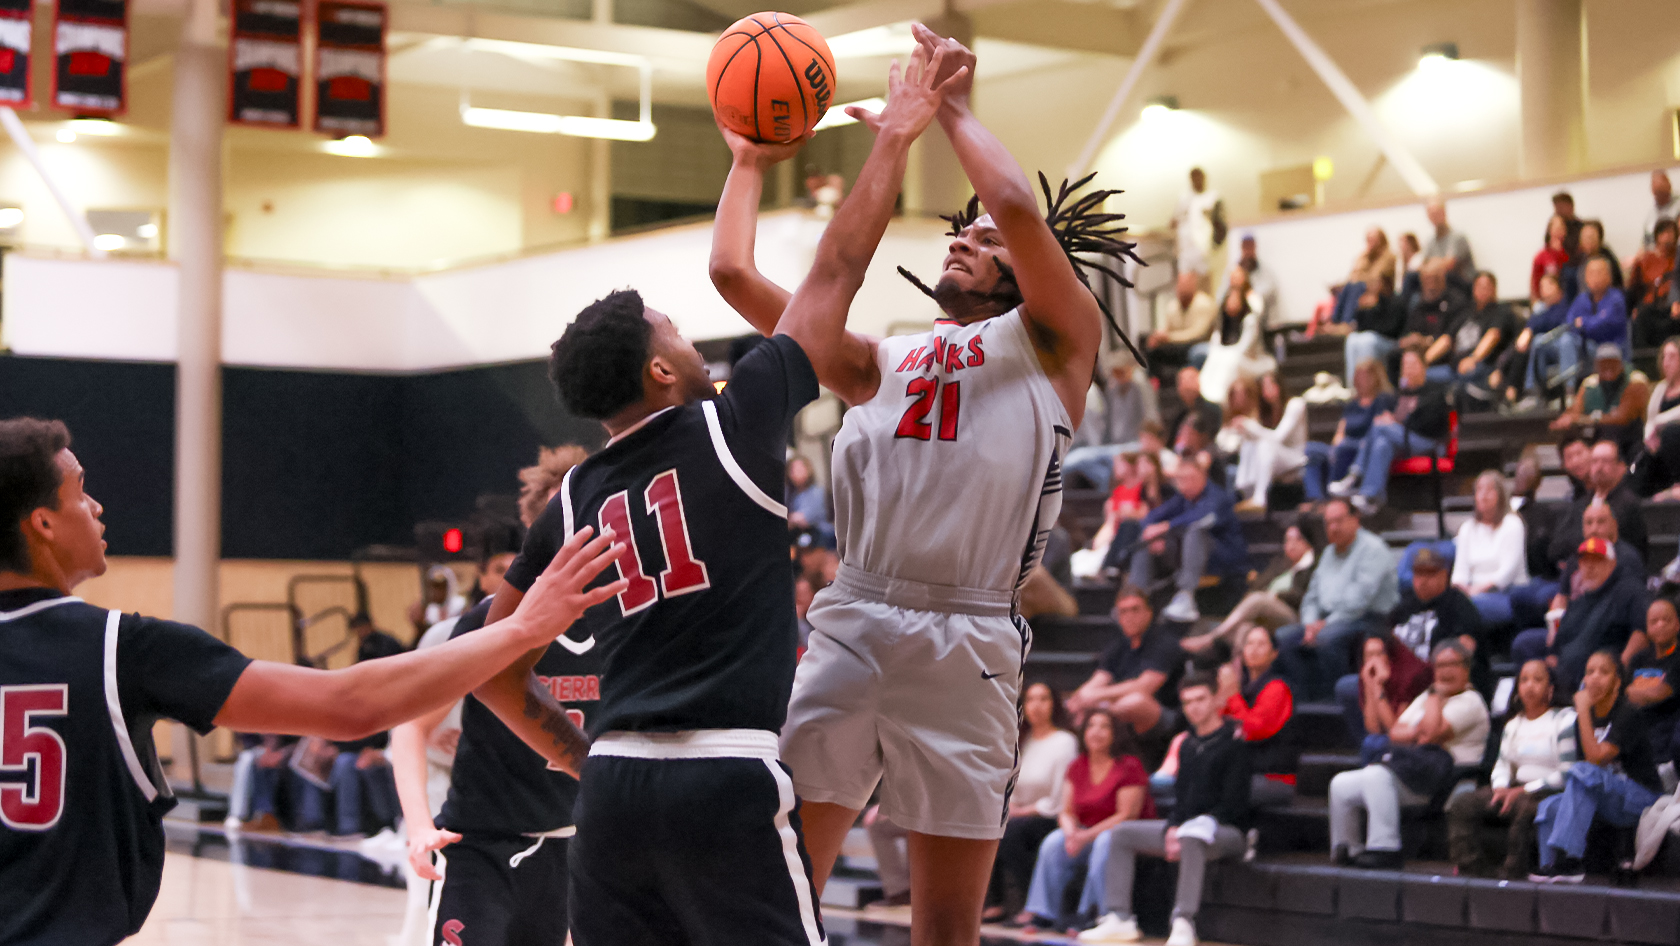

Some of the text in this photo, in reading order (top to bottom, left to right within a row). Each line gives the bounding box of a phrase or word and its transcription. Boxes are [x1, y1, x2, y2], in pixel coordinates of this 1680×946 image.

[893, 375, 961, 442] 21
[598, 468, 711, 618] 11
[537, 674, 604, 701] IERR
[0, 683, 69, 831] 5
